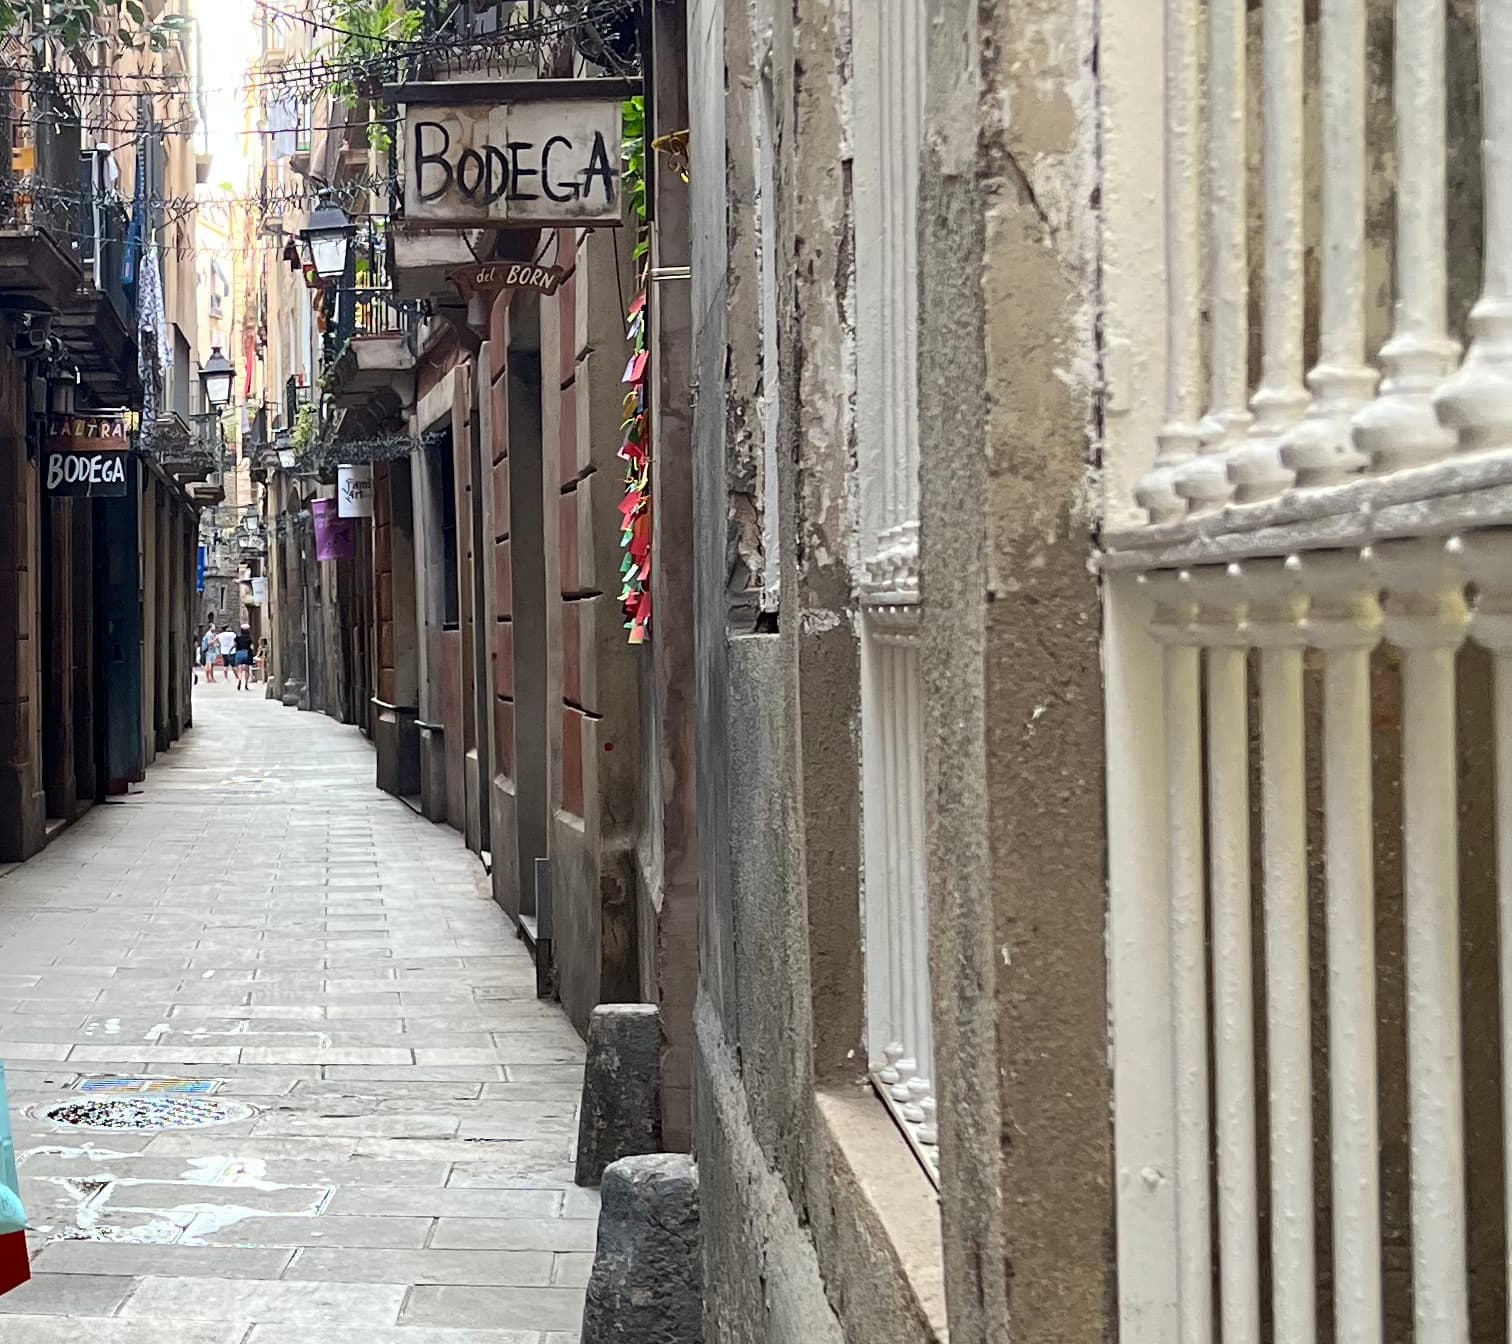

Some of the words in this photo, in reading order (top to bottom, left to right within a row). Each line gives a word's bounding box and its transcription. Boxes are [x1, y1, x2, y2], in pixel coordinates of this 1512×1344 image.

[414, 121, 619, 205] BODEGA
[475, 266, 496, 284] del
[506, 264, 555, 289] BORN
[46, 452, 125, 490] BODEGA
